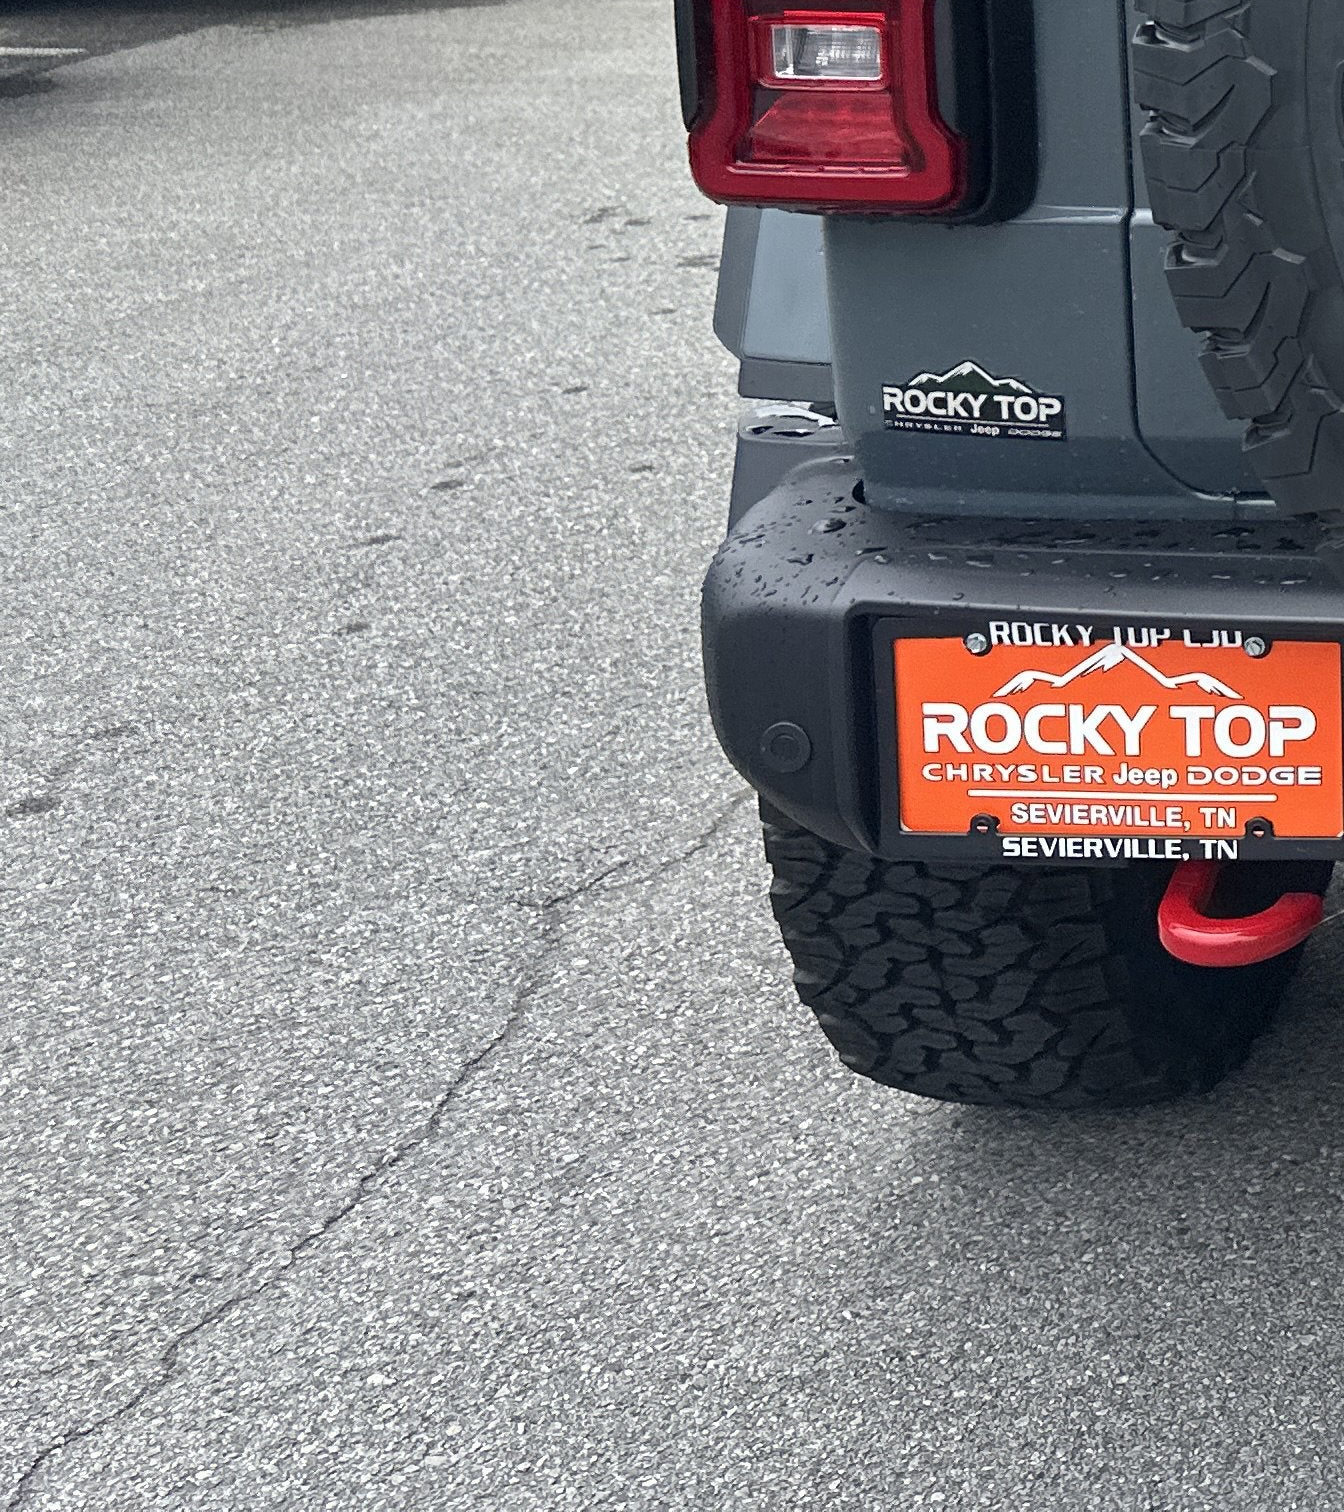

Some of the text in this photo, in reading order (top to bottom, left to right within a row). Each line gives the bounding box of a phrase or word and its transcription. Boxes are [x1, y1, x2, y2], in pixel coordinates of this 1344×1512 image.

[882, 386, 1062, 422] ROCKY TOP
[970, 423, 1000, 437] Jeep
[988, 620, 1094, 648] ROCKY
[921, 701, 1317, 759] ROCKY TOP
[921, 761, 1323, 789] CHRYSLER Jeep DODGE
[1010, 802, 1237, 832] SEVIERVILLE, TN
[1002, 837, 1239, 861] SEVIERVILLE, TN
